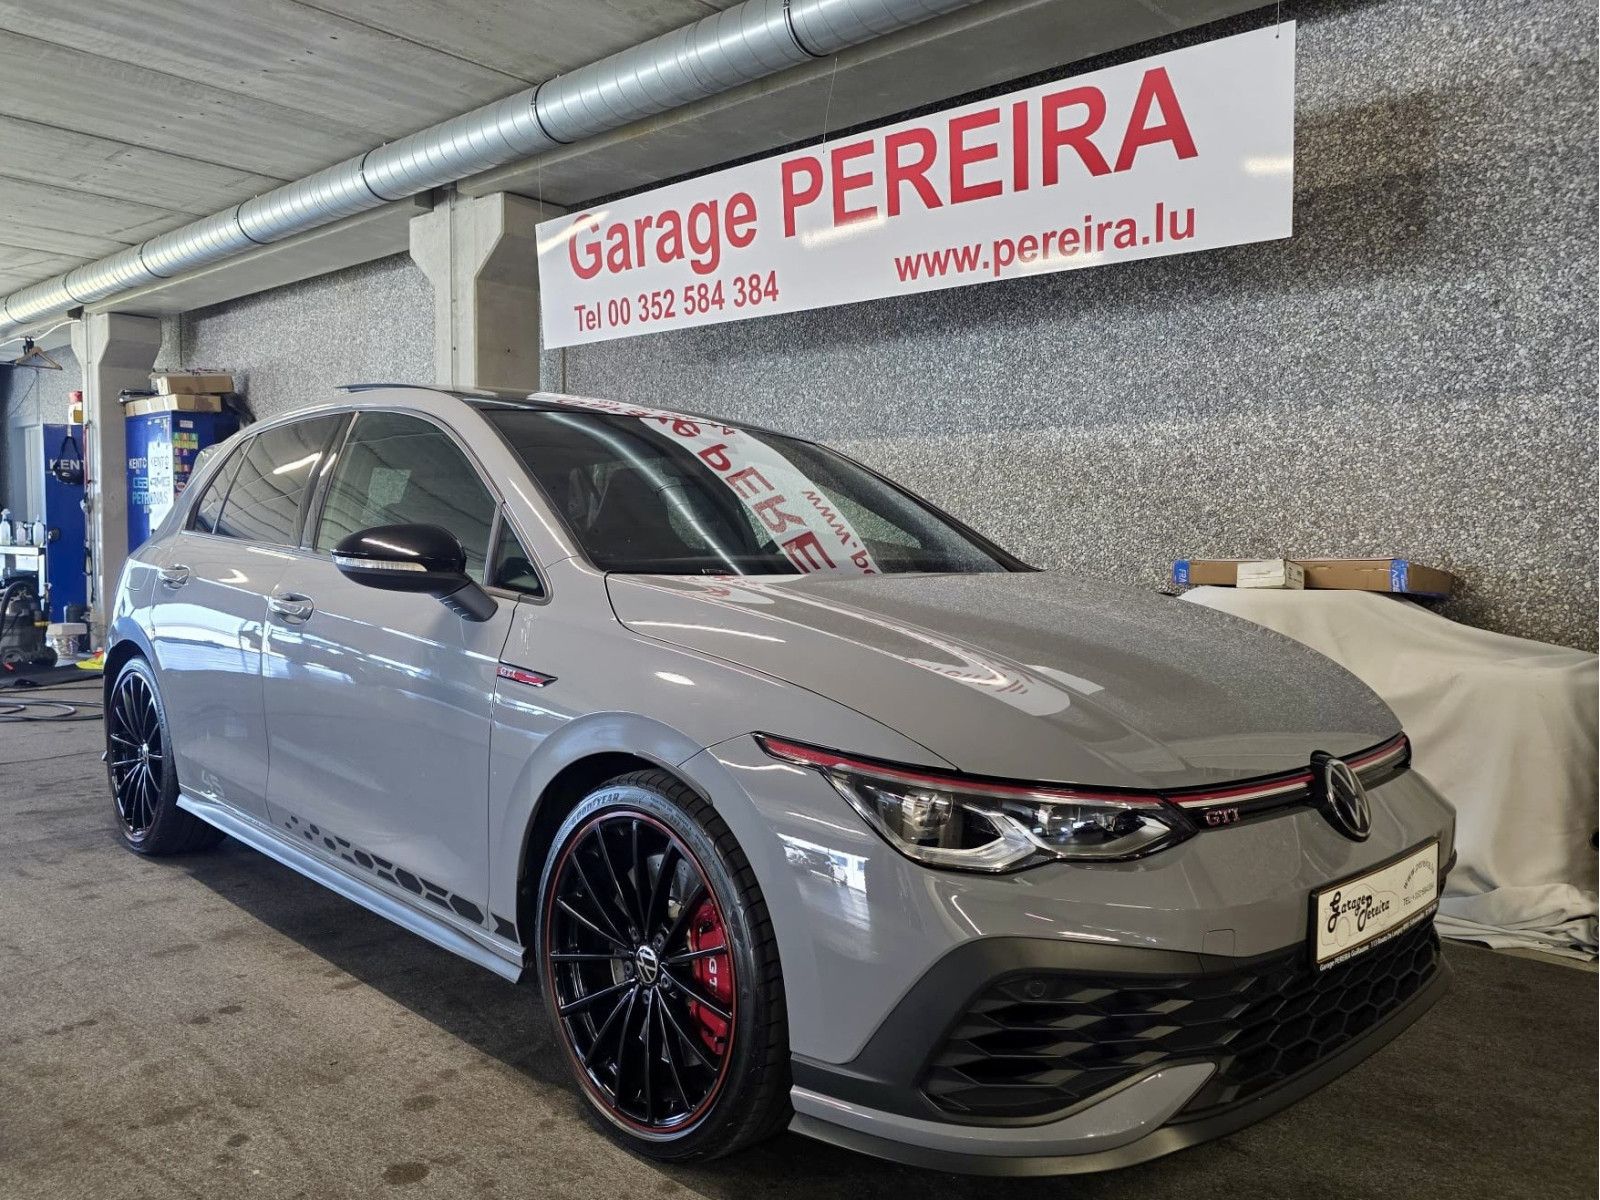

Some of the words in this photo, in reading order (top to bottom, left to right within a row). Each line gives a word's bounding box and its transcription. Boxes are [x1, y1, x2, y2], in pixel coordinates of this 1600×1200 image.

[567, 191, 758, 280] Garage
[780, 66, 1198, 238] PEREIRA
[895, 202, 1196, 285] www.pereira.lu
[574, 304, 602, 333] Tel
[608, 298, 633, 328] 00
[638, 290, 677, 322] 352
[683, 281, 725, 318] 584
[733, 269, 780, 309] 384
[49, 458, 84, 470] KEN
[500, 666, 516, 678] GTI
[571, 792, 620, 826] GOODYEAR
[1205, 807, 1240, 826] GTI
[1327, 890, 1366, 933] Garage
[1357, 894, 1390, 932] Pereira
